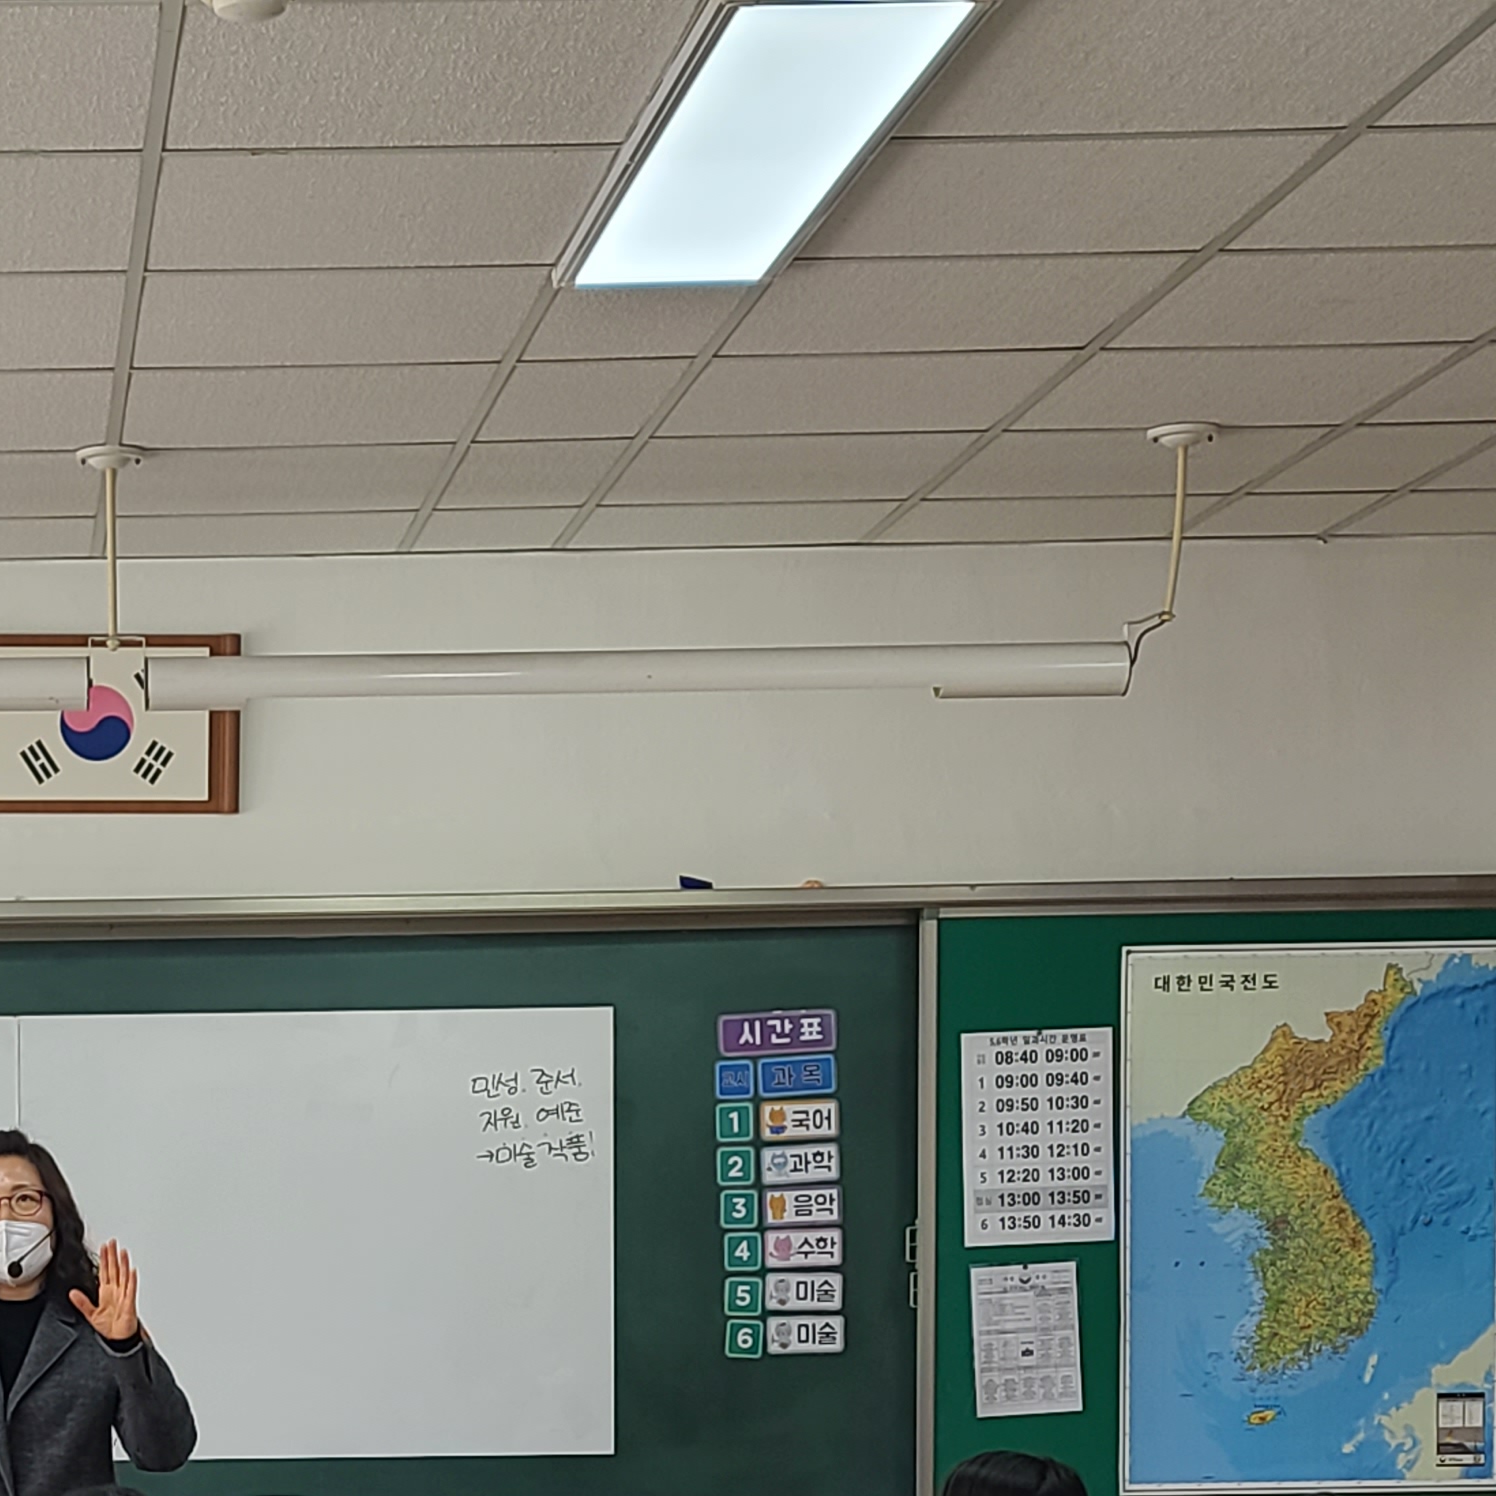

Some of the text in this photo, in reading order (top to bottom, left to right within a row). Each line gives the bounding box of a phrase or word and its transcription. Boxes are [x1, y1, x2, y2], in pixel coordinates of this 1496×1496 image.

[1154, 973, 1279, 993] 대한민국전도
[737, 1017, 824, 1046] 시간표
[995, 1050, 1039, 1065] 08:40
[1045, 1048, 1089, 1063] 09:00
[978, 1071, 1089, 1089] 1 09:00 09:40
[978, 1095, 1089, 1113] 2 09:50 10:30
[727, 1107, 833, 1134] 1 국어
[978, 1119, 1090, 1136] 3 10:40 11:20
[979, 1142, 1090, 1160] 4 11:30 12:10
[727, 1150, 835, 1178] 2 과학
[979, 1166, 1090, 1184] 5 12:20 13:00
[731, 1193, 837, 1219] 3 음악
[998, 1191, 1041, 1207] 13:00
[1048, 1190, 1091, 1205] 13:50
[981, 1213, 1091, 1231] 6 13:50 14:30
[733, 1236, 838, 1262] 4 수학
[735, 1279, 837, 1307] 5 미술
[736, 1321, 838, 1350] 6 미술
